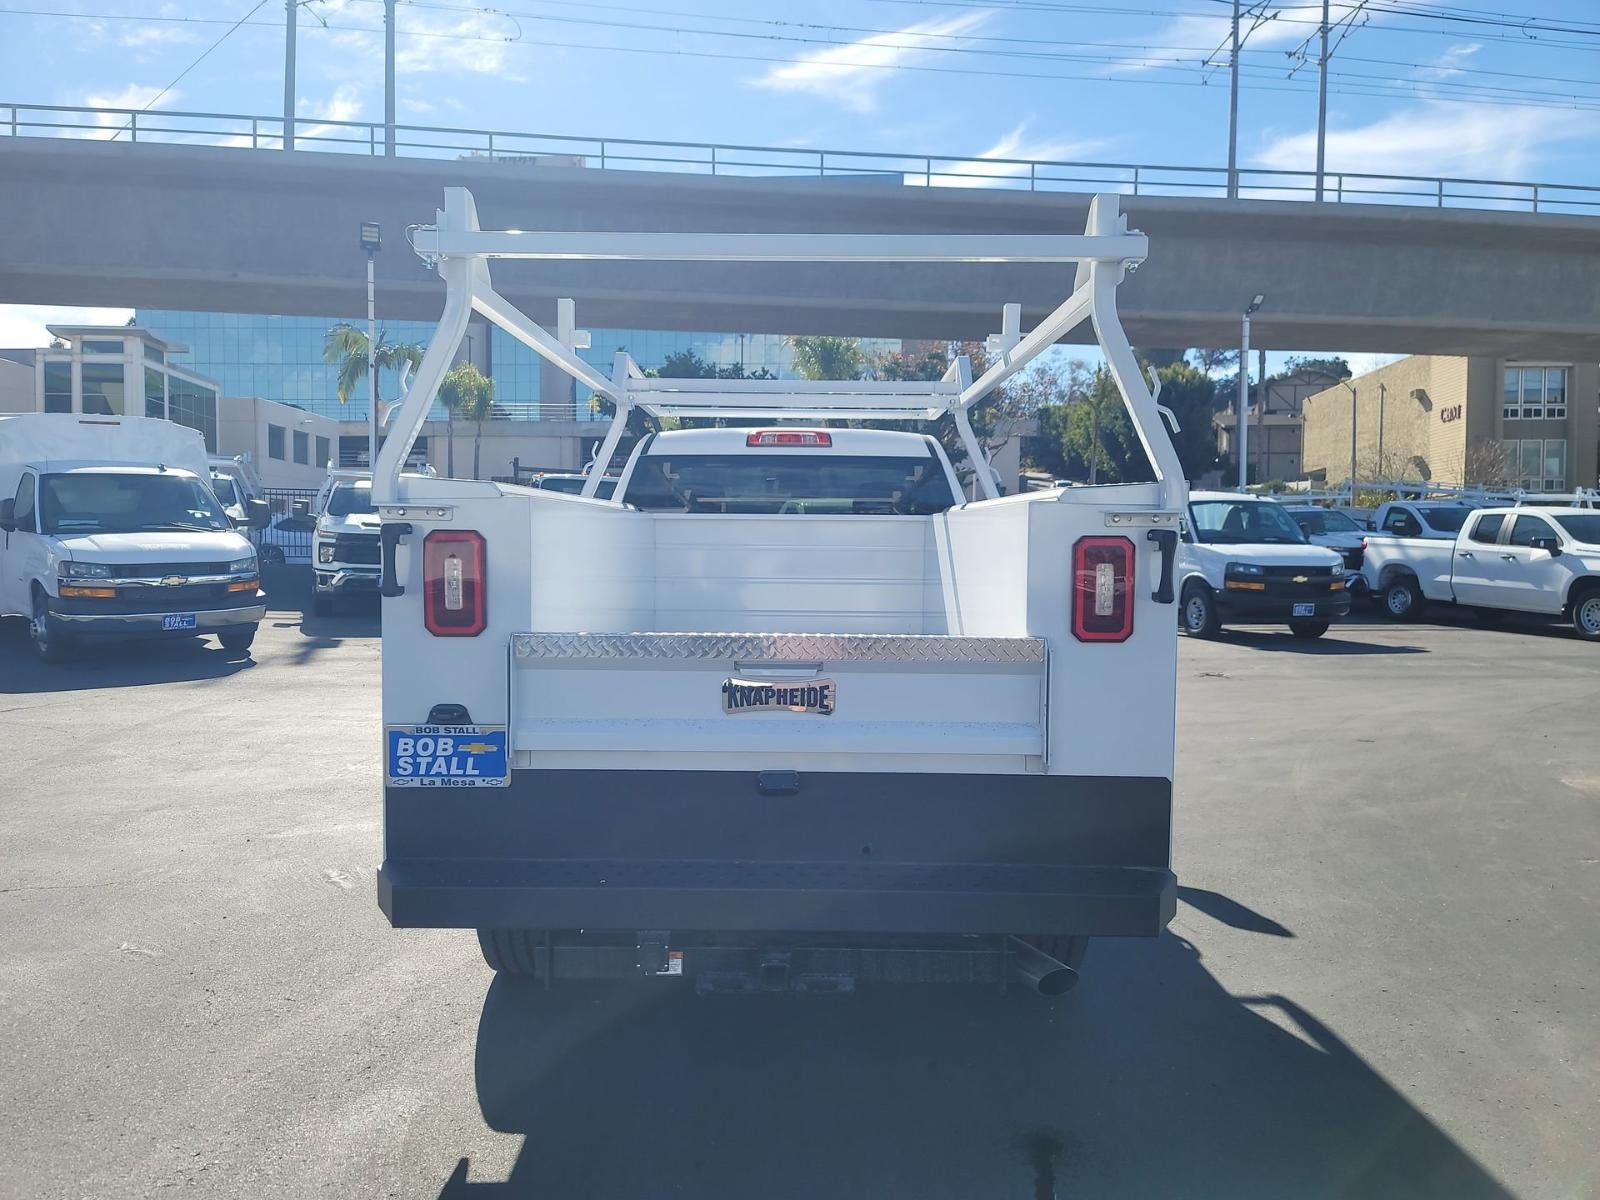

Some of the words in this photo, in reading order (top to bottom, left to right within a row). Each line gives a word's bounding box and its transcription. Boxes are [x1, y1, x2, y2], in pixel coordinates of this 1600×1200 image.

[727, 684, 830, 710] KNAPHEIDE
[397, 738, 454, 756] BOB
[397, 757, 480, 775] STALL
[440, 778, 476, 786] Mesa
